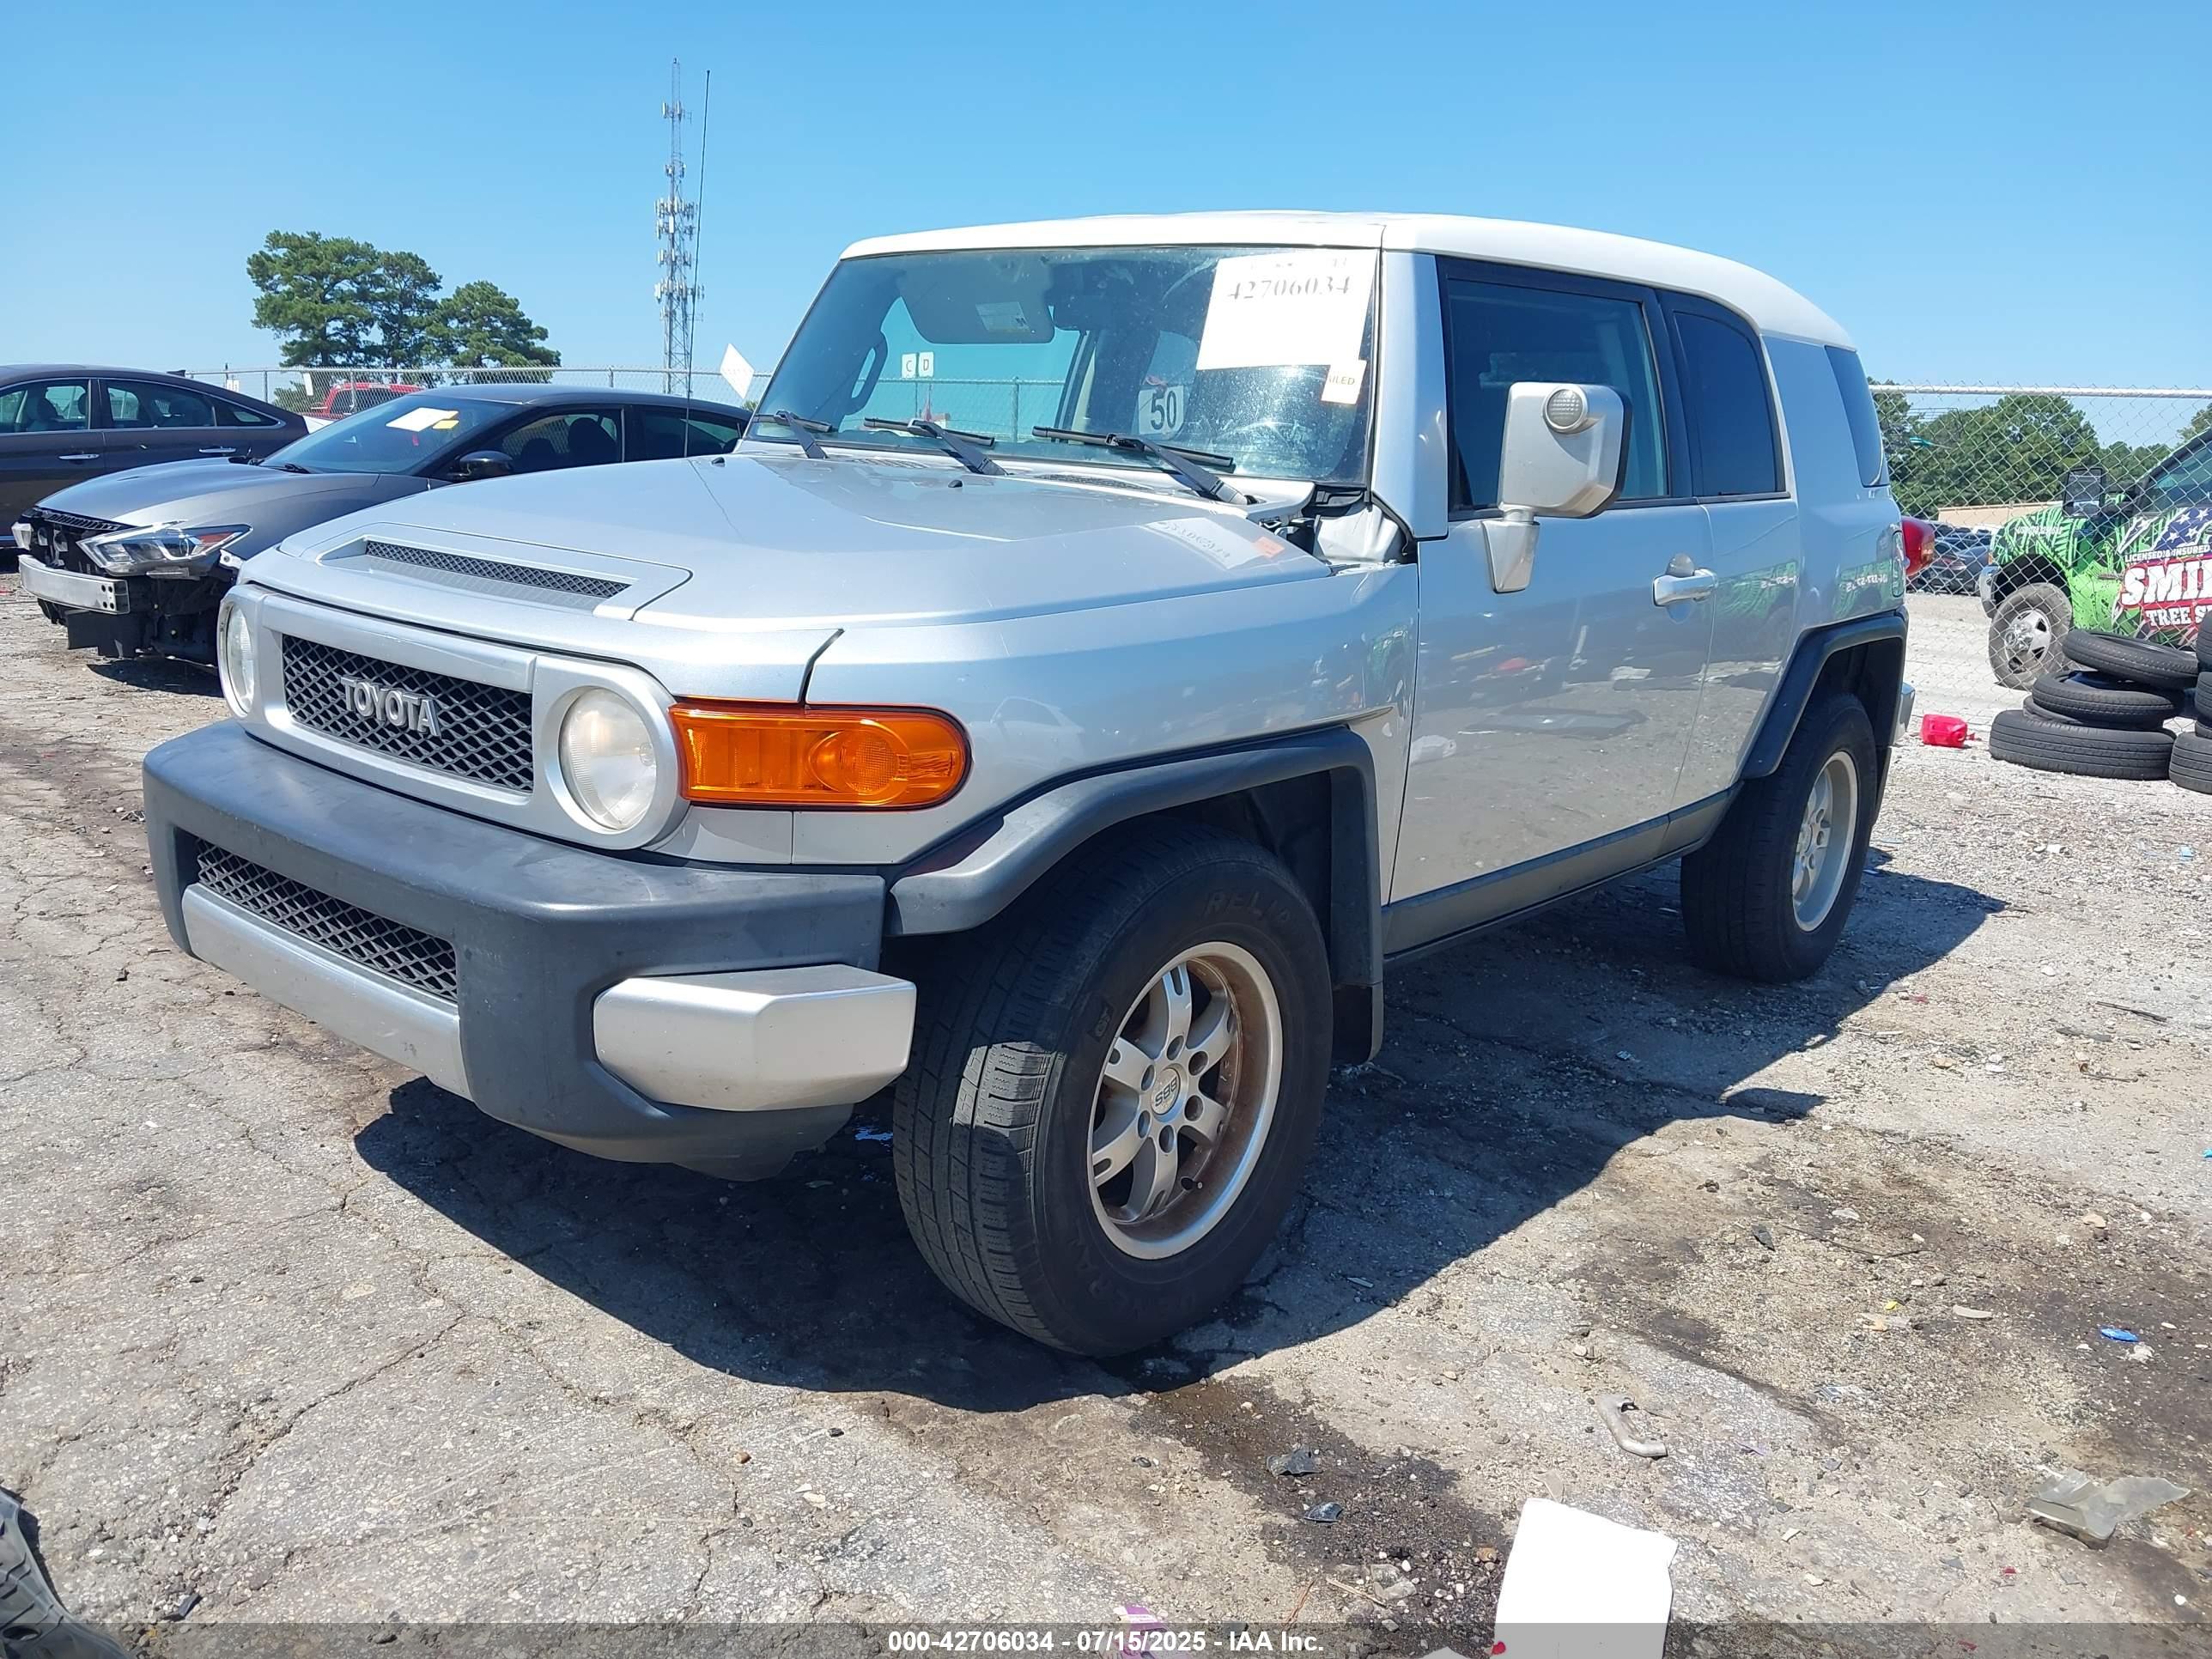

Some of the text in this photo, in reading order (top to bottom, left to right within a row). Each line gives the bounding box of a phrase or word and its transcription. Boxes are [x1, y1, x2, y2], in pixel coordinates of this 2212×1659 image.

[1227, 276, 1350, 300] 42706034
[905, 360, 913, 373] C
[922, 358, 930, 372] D
[1150, 392, 1176, 430] 50
[2124, 550, 2162, 562] LICENSED
[2173, 544, 2211, 557] INSURED
[2122, 560, 2212, 605] SMI
[2145, 606, 2191, 627] TREE
[341, 675, 442, 739] TOYOTA
[1154, 1076, 1177, 1108] BBS
